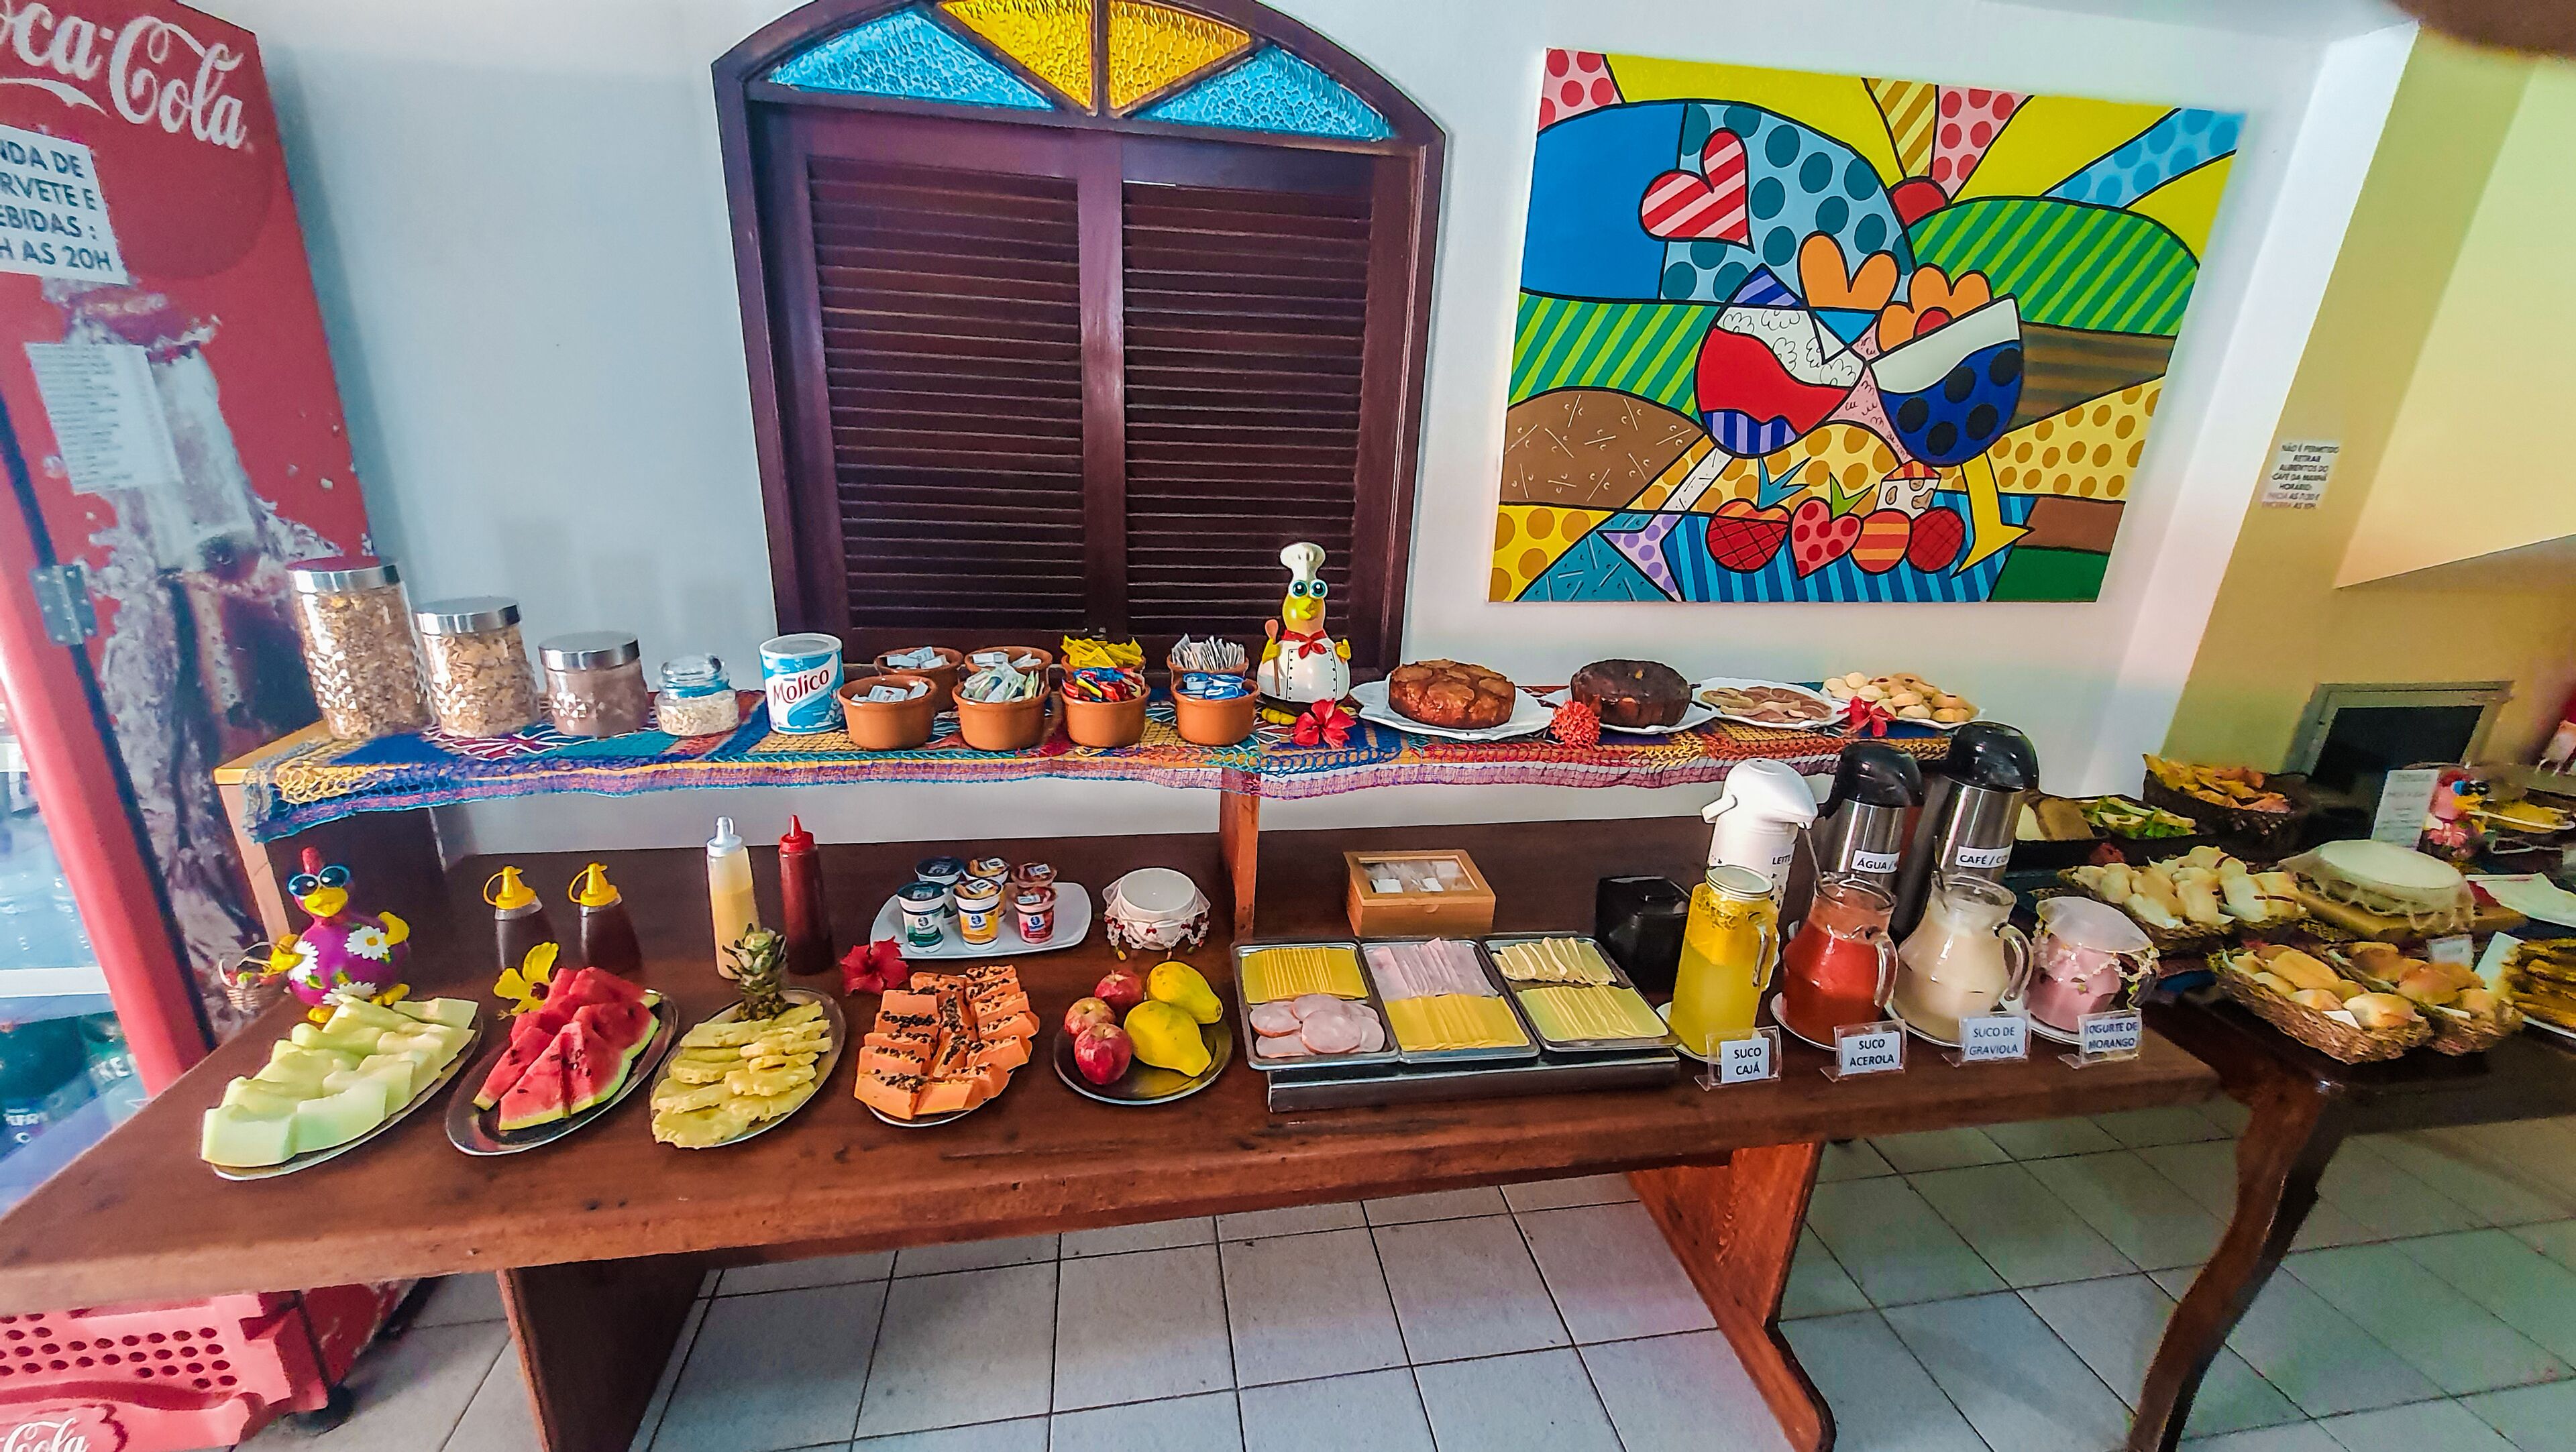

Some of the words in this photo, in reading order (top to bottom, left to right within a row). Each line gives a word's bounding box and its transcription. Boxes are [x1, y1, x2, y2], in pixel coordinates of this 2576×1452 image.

[50, 150, 85, 178] DE
[0, 172, 78, 207] RVETE
[82, 187, 98, 211] E
[23, 240, 56, 265] AS
[62, 245, 113, 272] 20H
[773, 669, 829, 706] Molico
[1857, 858, 1886, 870] ÁGUA
[1960, 854, 1987, 864] CAFÉ
[1974, 1027, 2000, 1038] SUCO
[2003, 1027, 2015, 1036] DE
[2086, 1023, 2124, 1034] IOGURTE
[2126, 1022, 2138, 1031] DE
[1859, 1039, 1886, 1050] SUCO
[1969, 1044, 2018, 1055] GRAVIOLA
[2088, 1038, 2135, 1050] MORANGO
[1734, 1048, 1762, 1059] SUCO
[1849, 1054, 1894, 1066] ACEROLA
[1736, 1062, 1760, 1075] CAJÁ
